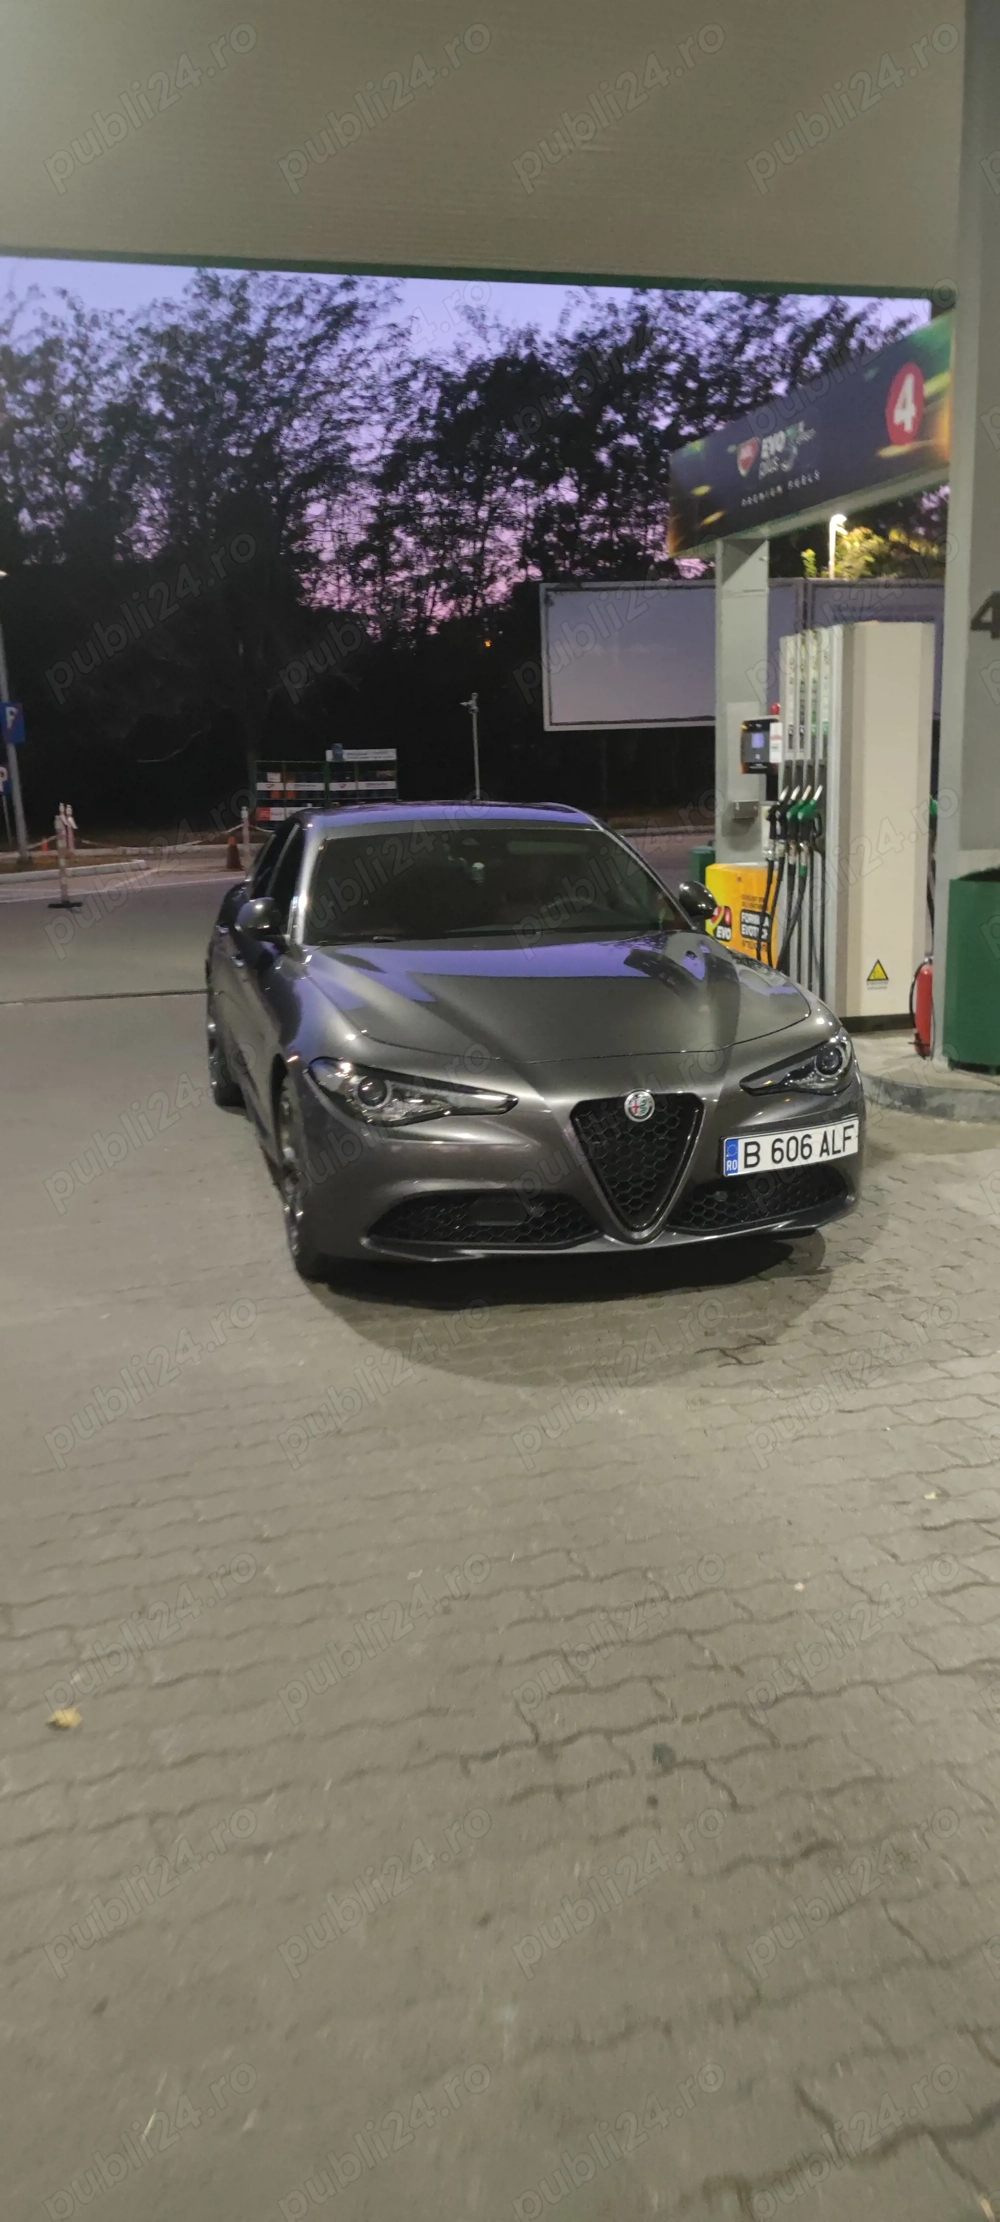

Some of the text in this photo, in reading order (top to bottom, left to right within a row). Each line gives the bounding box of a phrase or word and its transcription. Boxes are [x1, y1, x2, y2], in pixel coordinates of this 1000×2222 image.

[893, 373, 916, 432] 4
[970, 591, 1000, 640] 4
[717, 925, 732, 940] EVO
[726, 1159, 738, 1171] RO
[744, 1124, 855, 1169] B 606 ALF
